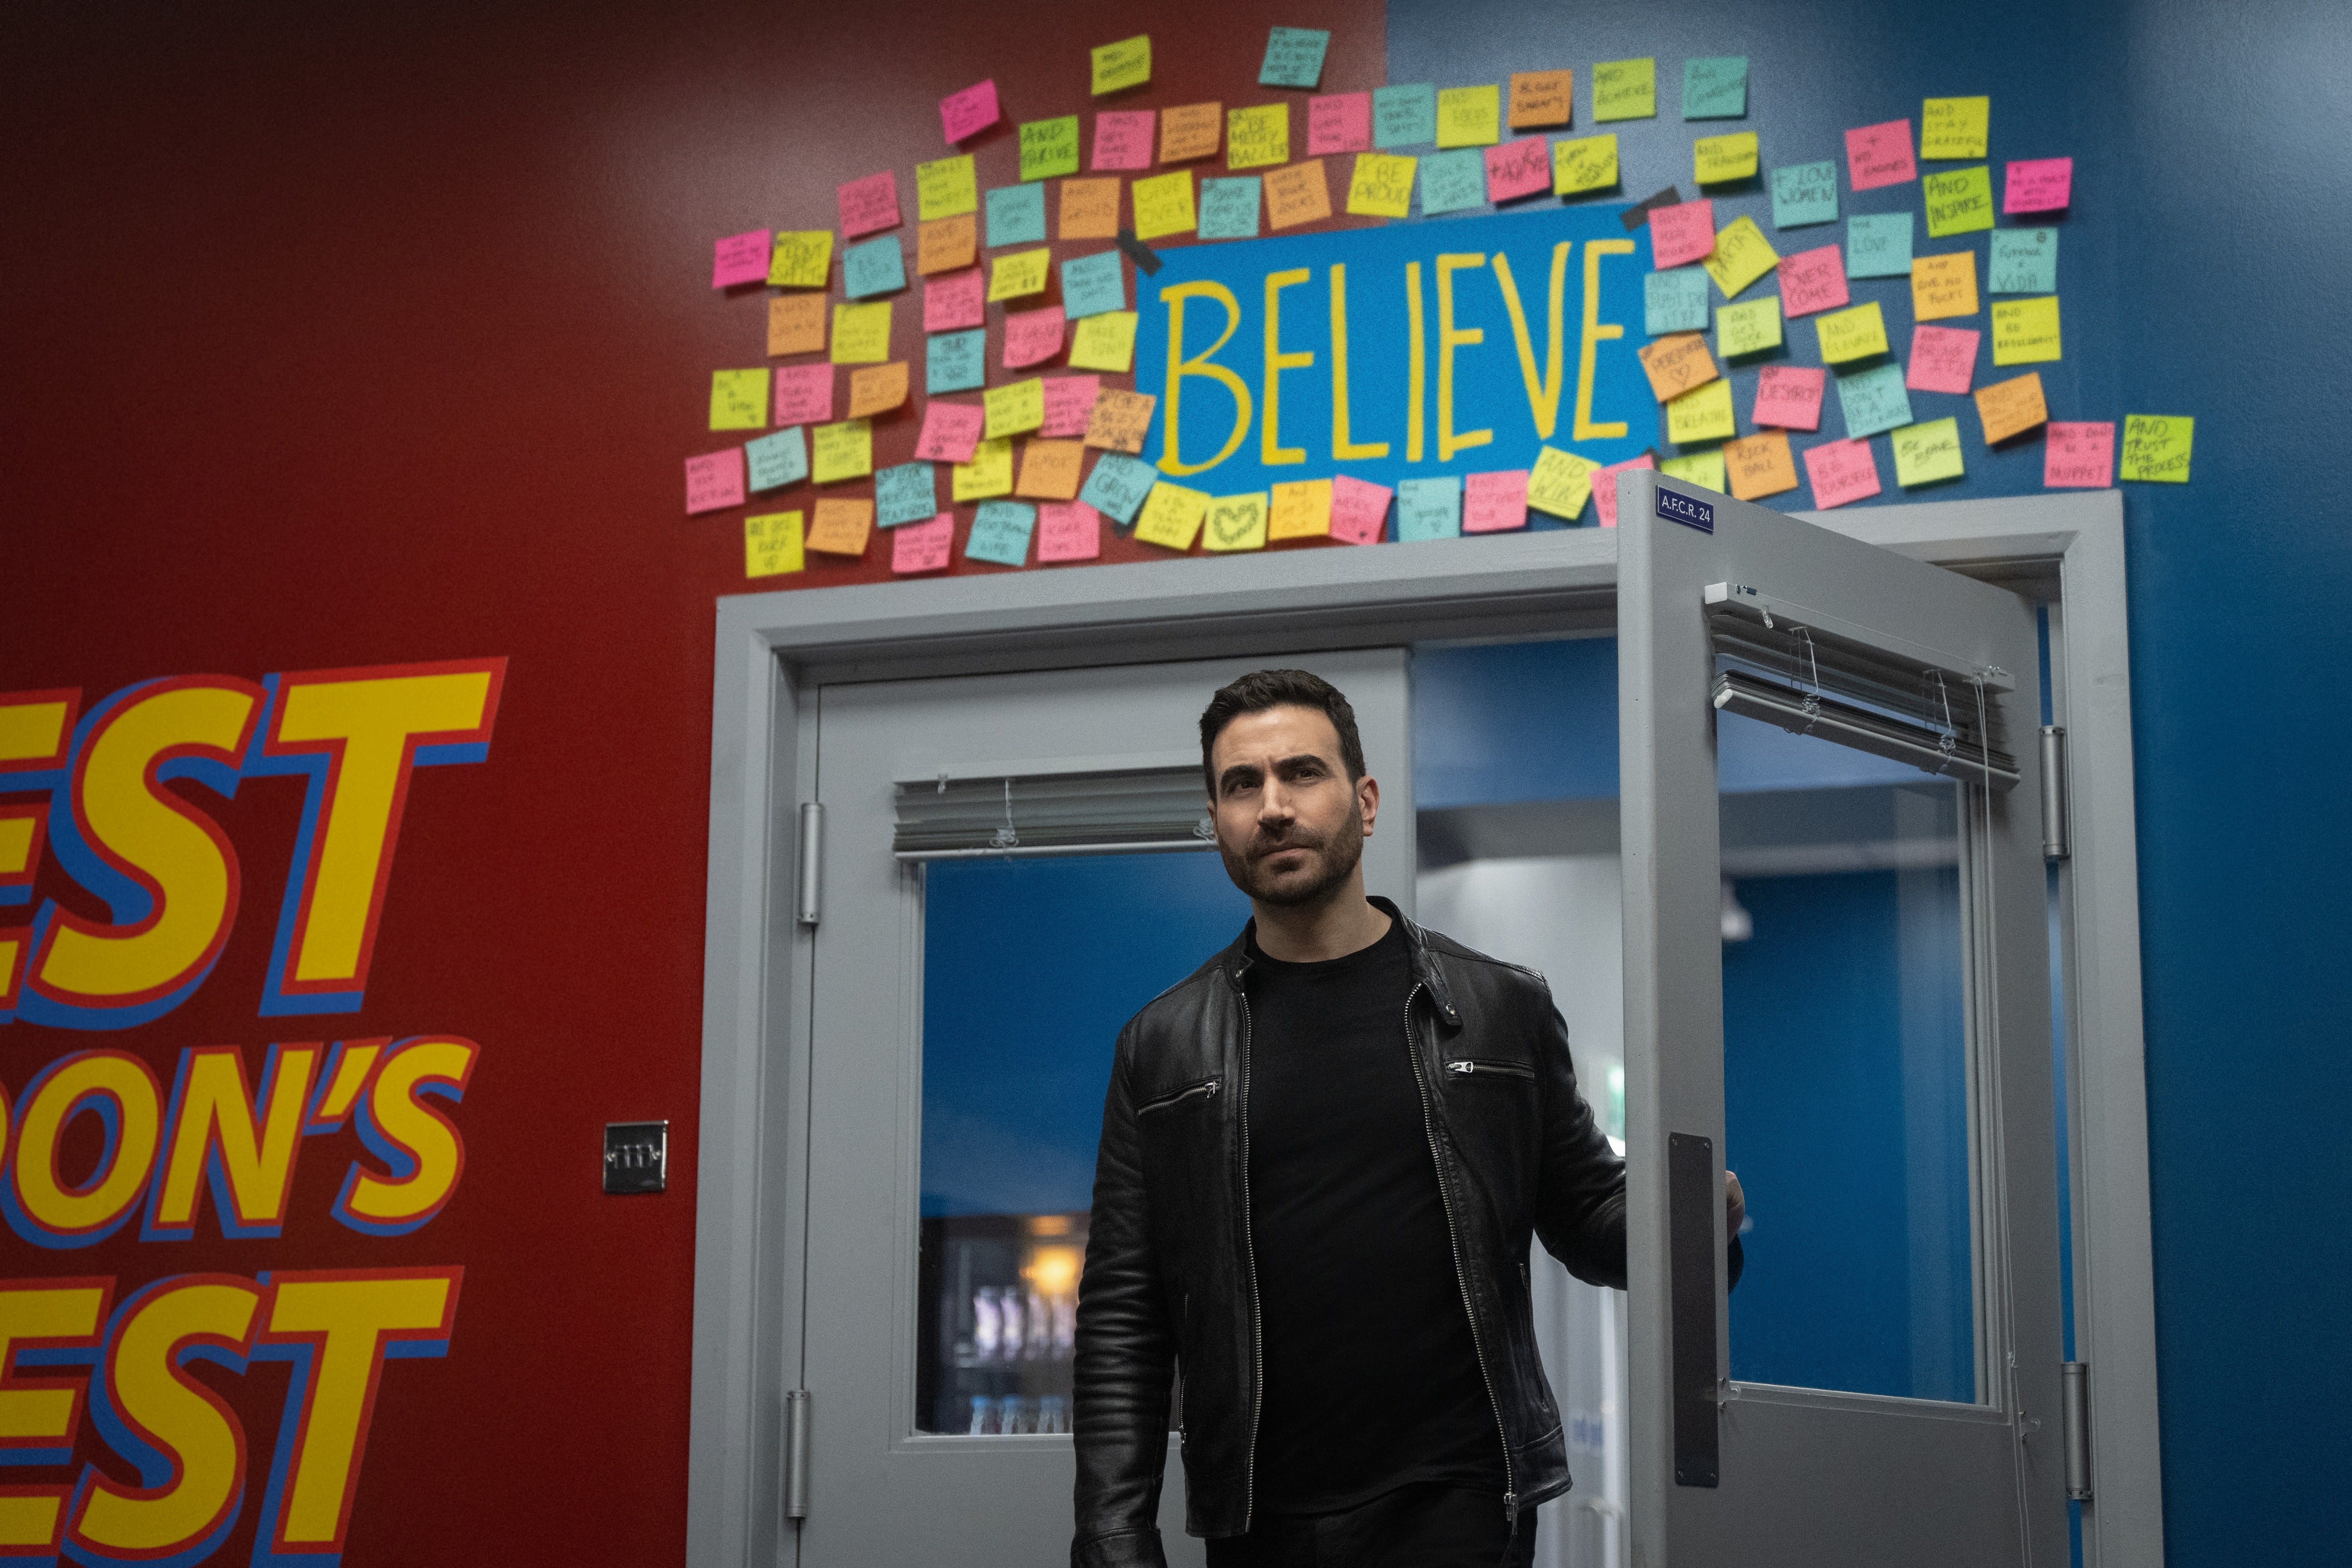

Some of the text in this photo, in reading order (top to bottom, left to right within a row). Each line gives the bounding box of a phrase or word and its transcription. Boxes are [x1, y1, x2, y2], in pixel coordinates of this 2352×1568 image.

[1929, 175, 1970, 197] AND
[1156, 239, 1635, 477] BELIEVE
[2130, 418, 2169, 438] AND
[2126, 437, 2178, 454] TRUST
[2126, 453, 2156, 466] THE
[2137, 451, 2189, 479] PROCESS
[1662, 495, 1710, 523] A.F.C.R. 24
[0, 656, 509, 1031] ST
[0, 1035, 481, 1250] ON'S
